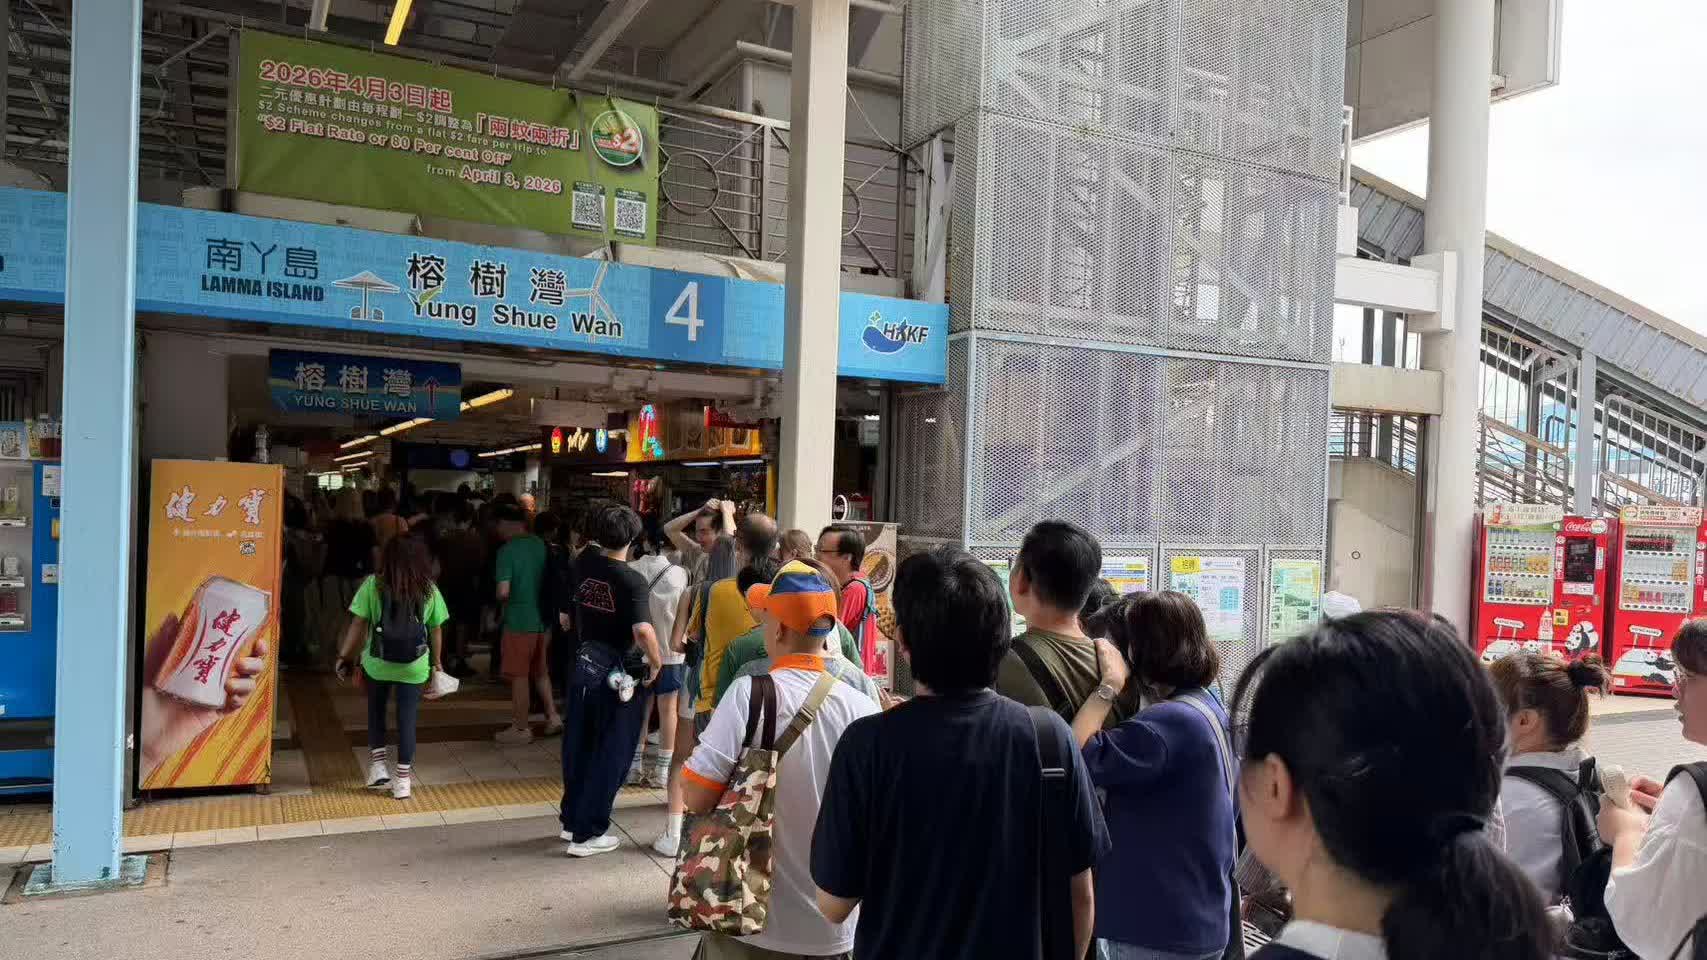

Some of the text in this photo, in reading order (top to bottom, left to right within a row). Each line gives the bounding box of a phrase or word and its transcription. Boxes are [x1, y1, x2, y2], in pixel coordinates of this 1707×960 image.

[260, 60, 452, 113] 2026年4月3日起
[258, 100, 547, 155] $2 Scheme changes from a flat $2 fare per trip to
[290, 118, 325, 137] Flat
[328, 124, 366, 142] Rate
[369, 133, 388, 146] or
[391, 135, 410, 149] 80
[414, 138, 442, 155] Per
[444, 145, 479, 161] cent
[427, 164, 455, 177] from
[460, 164, 501, 187] April
[503, 171, 520, 190] 3,
[524, 174, 562, 194] 2026
[206, 238, 319, 281] 南丫島
[406, 251, 567, 307] 榕樹灣
[201, 274, 324, 302] LAMMA ISLAND
[410, 292, 623, 338] Yung Shue Wan
[664, 280, 705, 342] 4
[294, 360, 416, 398] 榕樹灣
[295, 395, 417, 414] YUNG SHUE WAN
